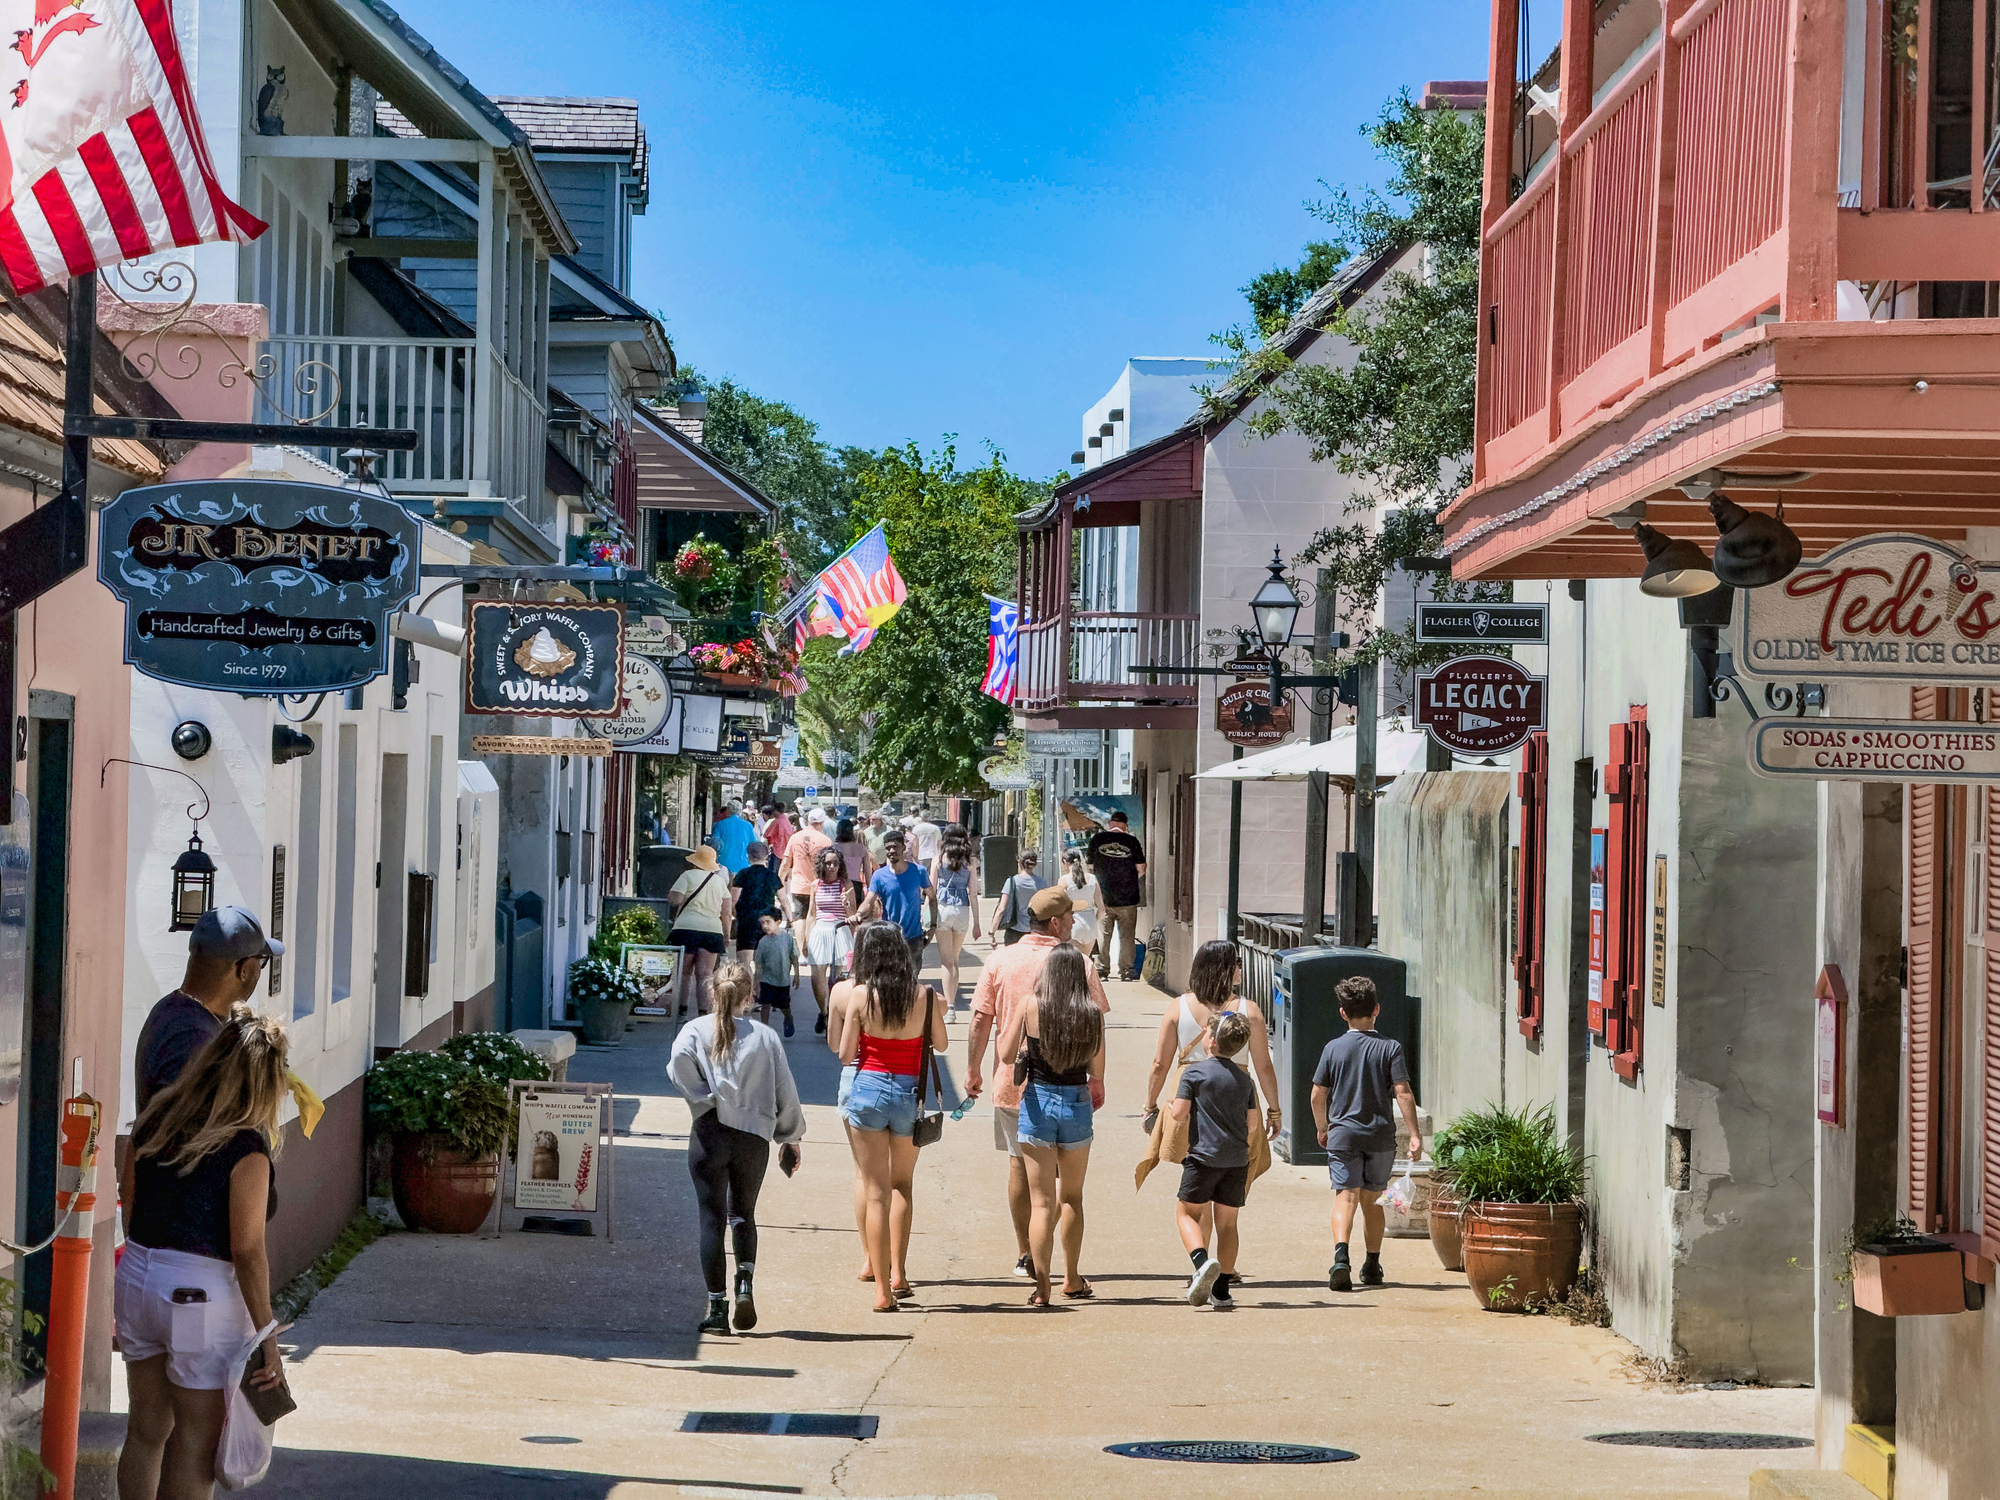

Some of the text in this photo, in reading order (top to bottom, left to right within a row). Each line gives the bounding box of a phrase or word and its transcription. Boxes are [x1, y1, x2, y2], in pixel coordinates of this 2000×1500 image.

[231, 526, 381, 561] BENET
[151, 617, 362, 643] Handcrafted Jewelry & Gifts
[1424, 617, 1540, 627] FLAGLER COLLEGE
[496, 611, 595, 680] SWEET & SORY WAFFLE COMPANY
[1753, 639, 2000, 664] OLDE TYME ICE CRE
[223, 662, 287, 679] Since 1979
[1449, 672, 1513, 681] FLAGLER'S
[499, 678, 589, 704] Whips
[1221, 689, 1288, 707] BULL & CRON
[1430, 683, 1532, 709] LEGACY
[603, 721, 645, 738] Crêpes
[1471, 718, 1481, 727] FC
[477, 741, 508, 749] SAVORY
[1445, 729, 1516, 745] TOURS GIFTS
[1782, 730, 1996, 751] SODAS SMOOTHIES
[1067, 746, 1086, 754] Shop
[1814, 752, 1965, 771] CAPPUCCINO
[562, 1120, 593, 1128] BUTTER
